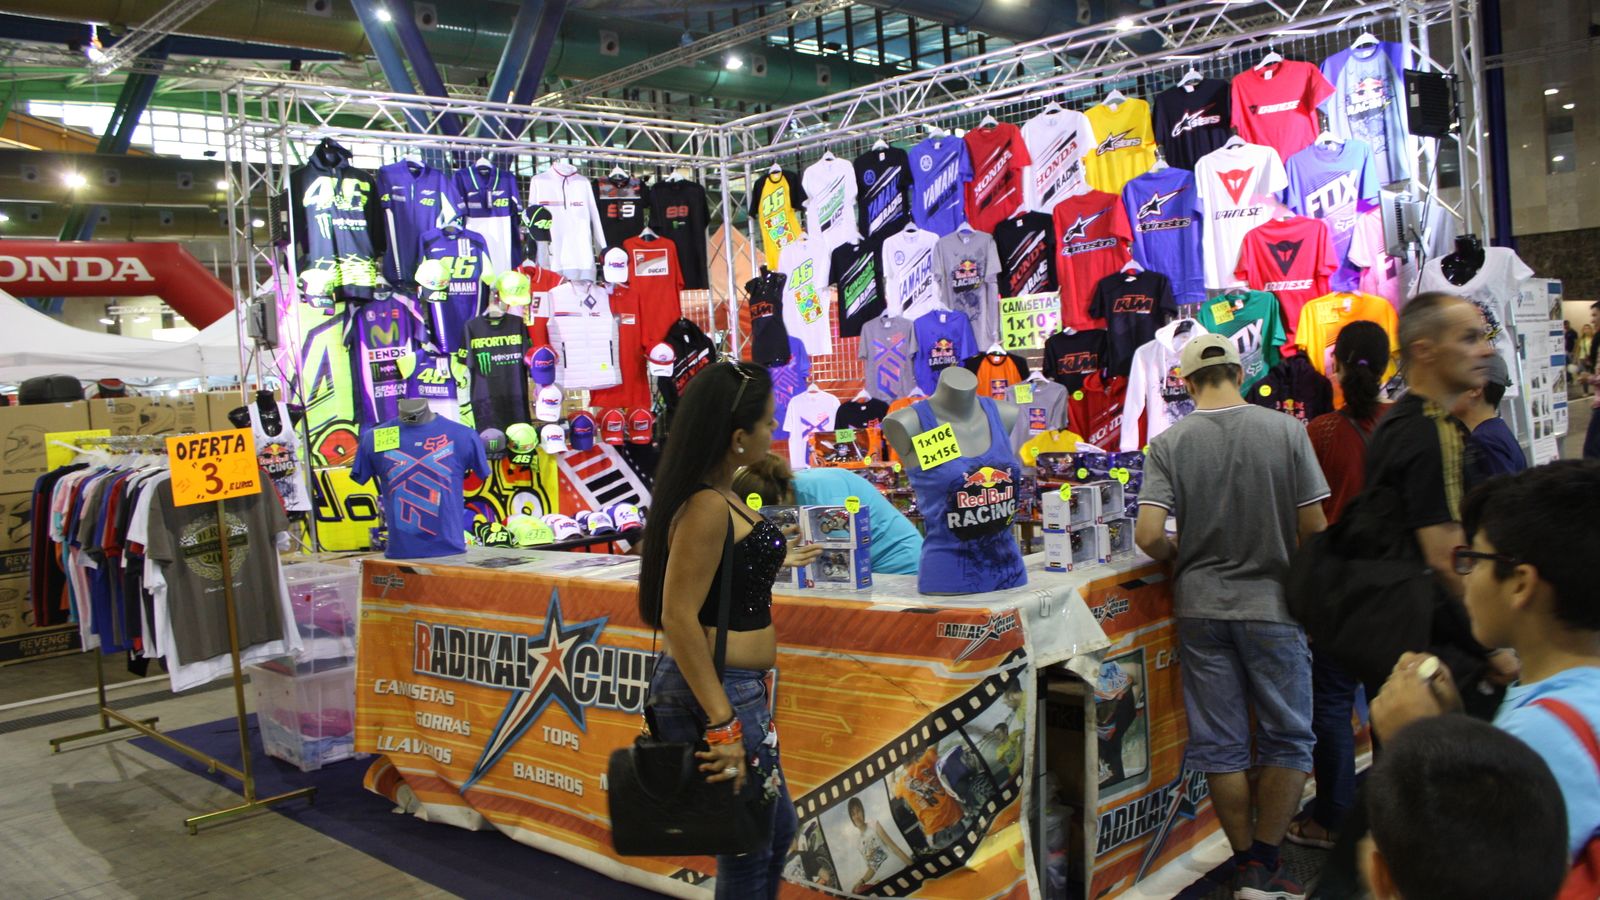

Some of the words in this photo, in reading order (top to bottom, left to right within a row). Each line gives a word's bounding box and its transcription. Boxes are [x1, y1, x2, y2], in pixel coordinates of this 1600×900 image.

[974, 151, 1013, 195] HONDA
[1036, 142, 1078, 186] HONDA
[303, 176, 371, 210] 46
[923, 158, 960, 210] YAMAHA
[1305, 170, 1359, 218] FOX
[419, 197, 436, 207] 46
[493, 198, 509, 207] 46
[762, 186, 785, 218] 46
[1136, 217, 1192, 232] alpinestars
[1062, 237, 1117, 257] alpinestars
[0, 256, 154, 282] ONDA
[789, 257, 814, 291] 46
[953, 275, 981, 287] RACING
[449, 281, 477, 293] AMAHA
[1114, 296, 1153, 313] KTM
[1229, 318, 1264, 355] OX
[491, 352, 523, 362] MONSTER
[928, 355, 956, 367] RACING
[1058, 352, 1099, 374] KTM
[425, 386, 449, 394] YAMAHA
[176, 434, 246, 461] OFERTA
[917, 427, 953, 449] 1x10€
[512, 454, 532, 464] 46
[922, 443, 959, 465] 2x15€
[264, 461, 297, 475] ACING
[956, 491, 987, 509] Red
[988, 485, 1014, 503] Bull
[947, 499, 1017, 530] RACING
[486, 532, 508, 544] 46
[5, 554, 31, 567] REVE
[936, 622, 983, 641] RADIKAL
[995, 614, 1017, 634] CLUB
[19, 632, 72, 650] REVENGE
[414, 621, 533, 691] RADIKAL
[374, 679, 456, 706] CAMISETAS
[415, 711, 471, 737] GORRAS
[376, 735, 453, 764] LLAVEROS
[542, 726, 580, 750] TOPS
[513, 762, 584, 796] BABEROS
[1096, 786, 1169, 856] ADIKAL
